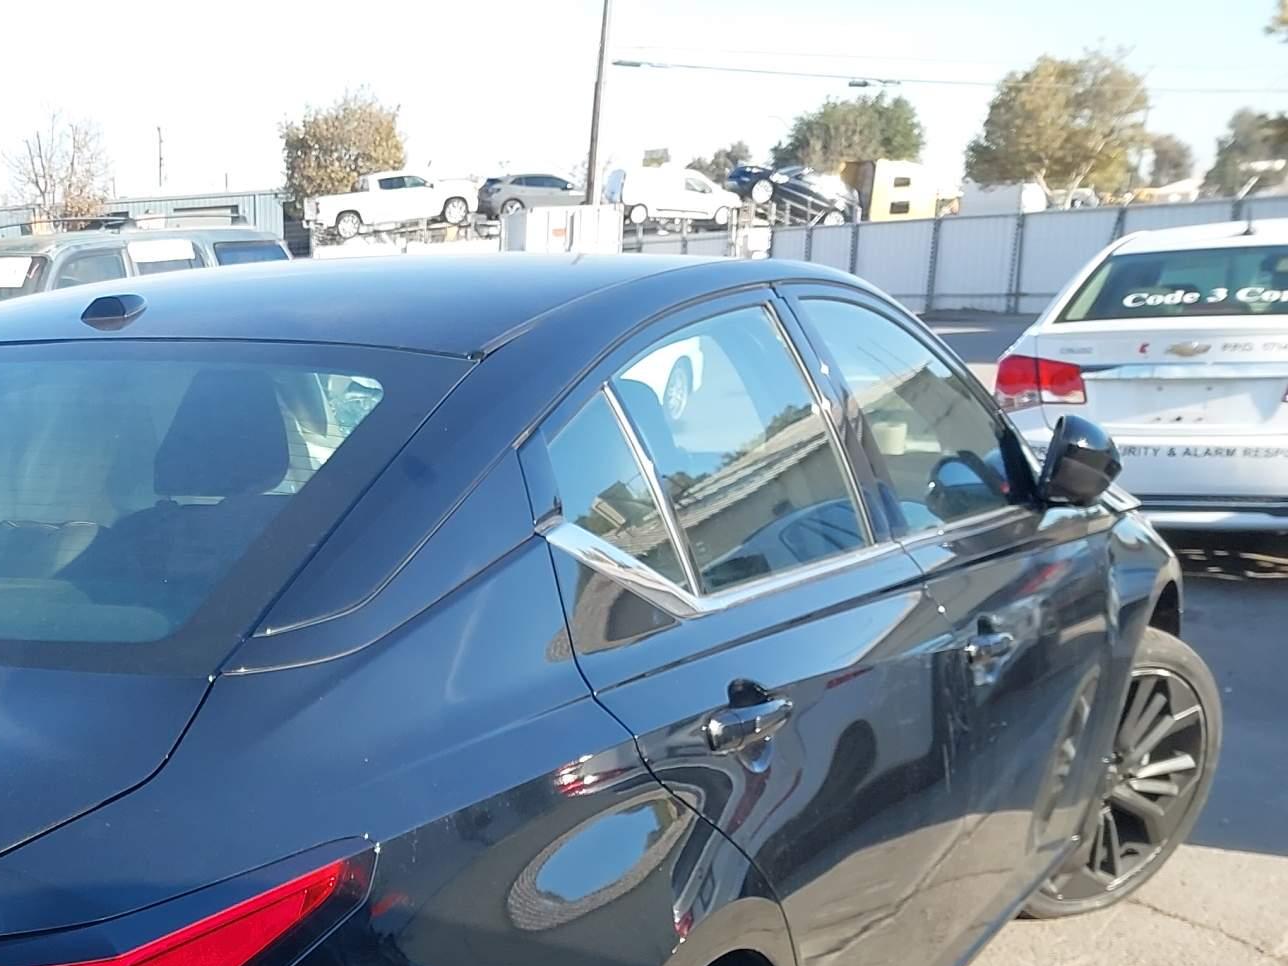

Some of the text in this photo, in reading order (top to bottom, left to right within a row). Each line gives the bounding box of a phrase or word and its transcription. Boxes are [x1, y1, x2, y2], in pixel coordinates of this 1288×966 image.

[1122, 289, 1201, 308] Code
[1207, 287, 1230, 303] 3
[1168, 447, 1177, 457] &
[1183, 447, 1237, 457] ALARM
